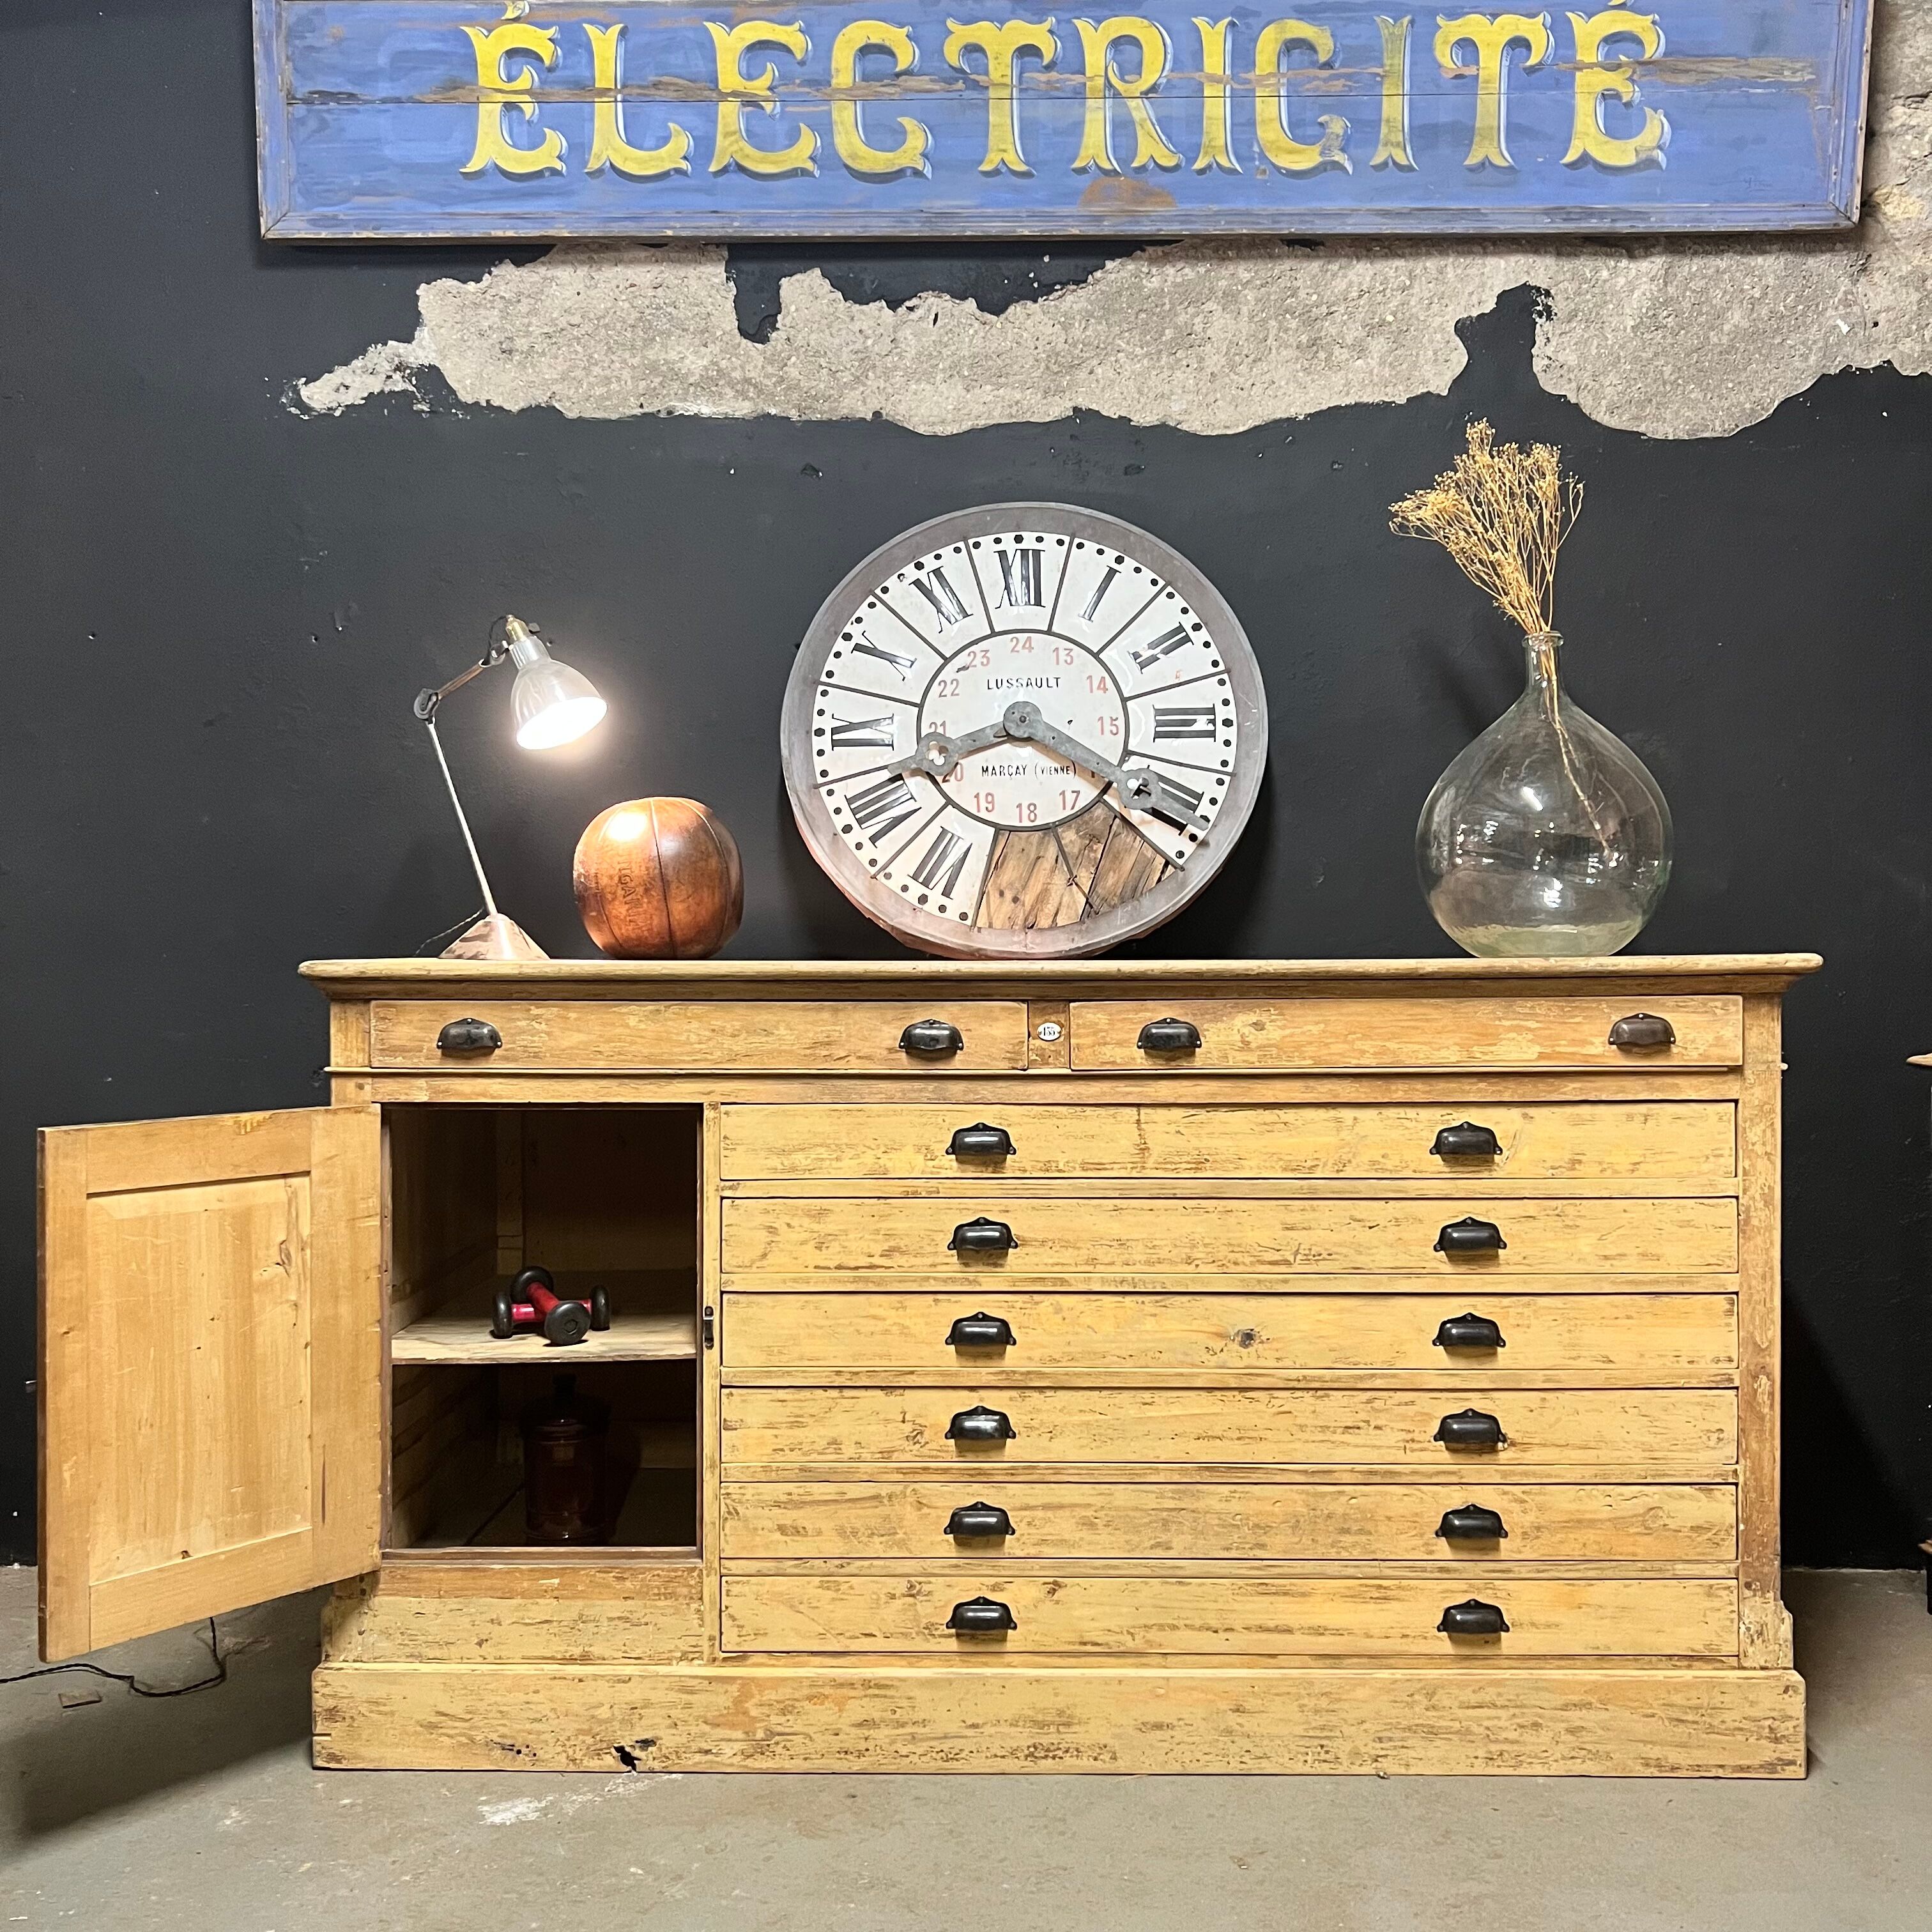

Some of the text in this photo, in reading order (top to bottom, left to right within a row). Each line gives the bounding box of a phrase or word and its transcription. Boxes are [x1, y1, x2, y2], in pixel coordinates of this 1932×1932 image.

[459, 0, 1669, 178] ÉLECTRICITÉ
[993, 548, 1046, 610] XII
[908, 565, 974, 634] XI
[1077, 565, 1122, 623] I
[850, 630, 918, 682] X
[1009, 636, 1034, 654] 24
[1126, 621, 1195, 675] II
[967, 649, 991, 668] 23
[1052, 647, 1075, 666] 13
[938, 678, 960, 698] 22
[986, 677, 1061, 690] LUSSAULT
[1085, 675, 1108, 694] 14
[831, 713, 894, 751] IX
[1097, 716, 1119, 736] 15
[1151, 703, 1216, 742] III
[981, 764, 1027, 780] MARÇAY
[1034, 759, 1077, 780] (VIENNE)
[843, 772, 923, 849] VIII
[974, 792, 995, 813] 19
[1059, 789, 1081, 811] 17
[1015, 802, 1038, 824] 18
[907, 825, 974, 900] VII
